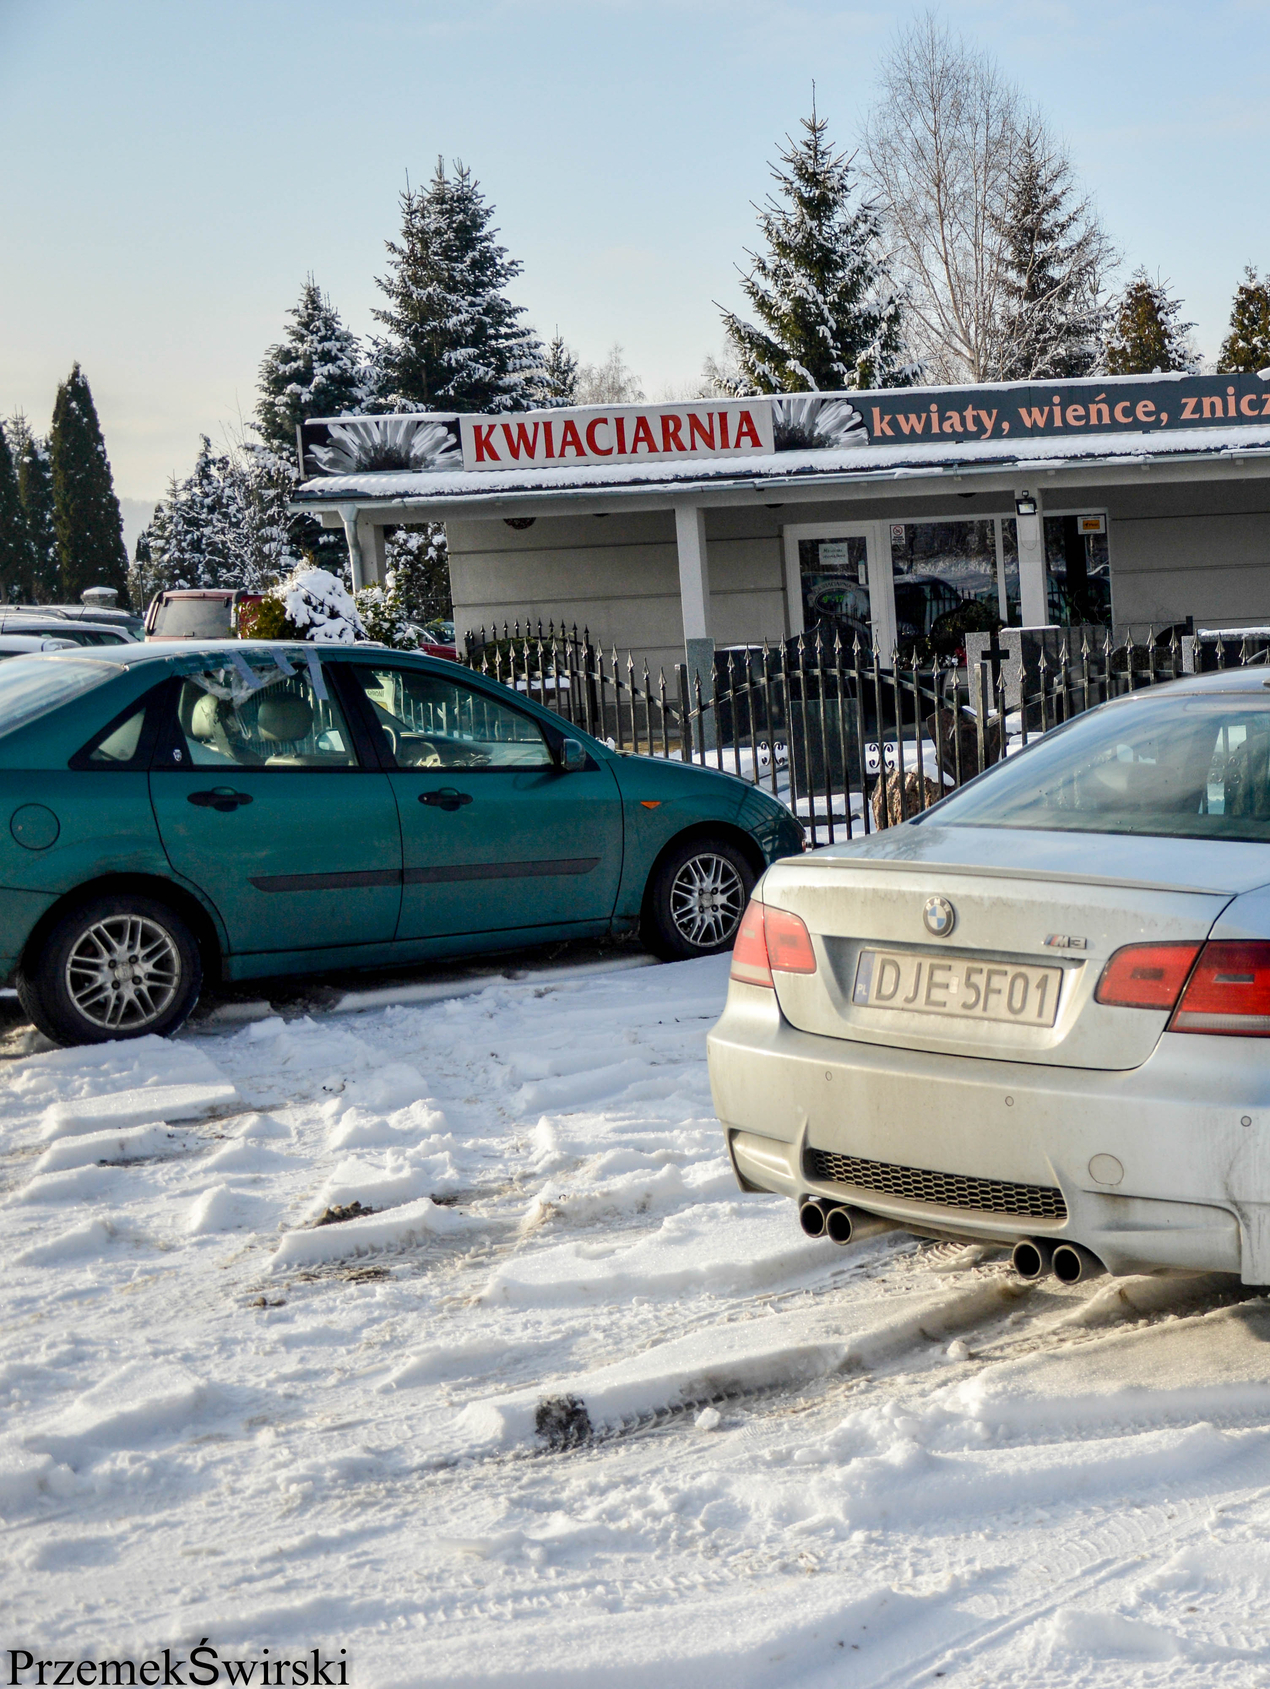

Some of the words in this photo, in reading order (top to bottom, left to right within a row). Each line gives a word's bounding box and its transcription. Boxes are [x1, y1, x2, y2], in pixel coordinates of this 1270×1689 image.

[472, 410, 764, 463] KWIACIARNIA
[871, 403, 1010, 440] kwiaty,
[1018, 392, 1169, 429] wieńce,
[1047, 934, 1088, 949] M3
[856, 982, 868, 996] PL
[875, 958, 952, 1008] DJE
[961, 966, 1049, 1018] 5F01
